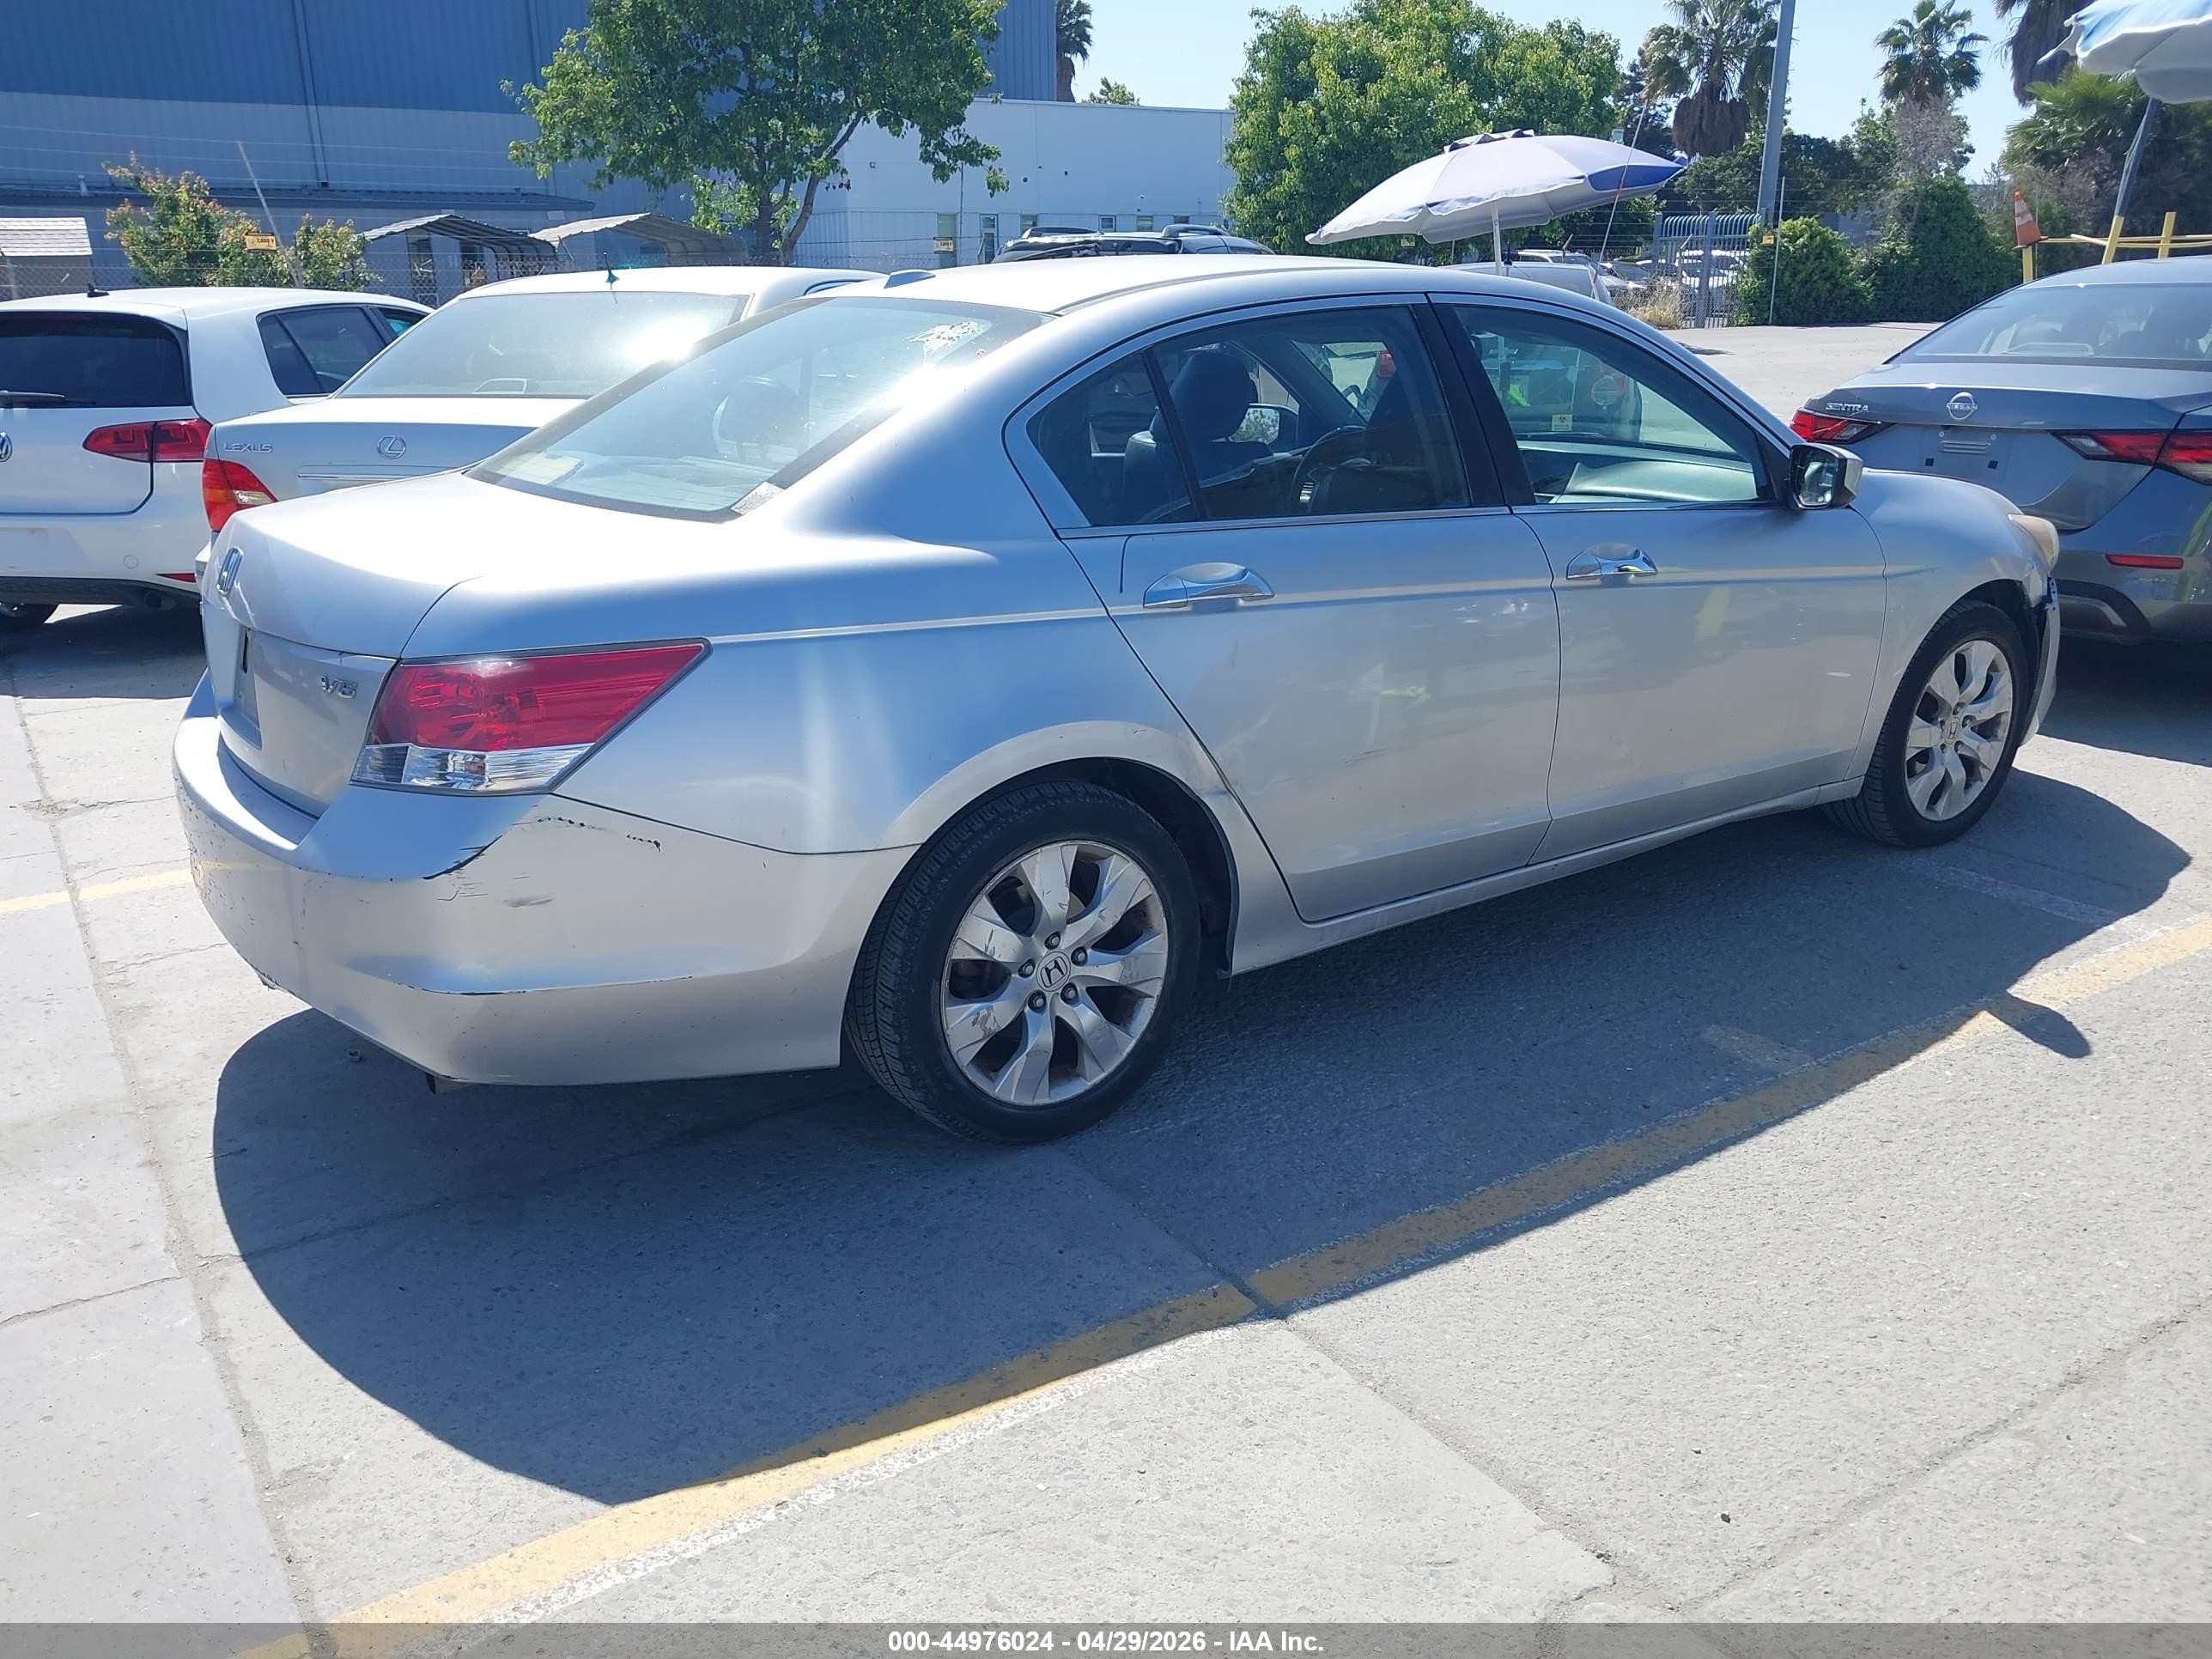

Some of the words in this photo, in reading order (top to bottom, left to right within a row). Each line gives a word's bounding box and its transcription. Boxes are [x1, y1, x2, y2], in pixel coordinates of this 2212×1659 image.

[1826, 402, 1869, 412] SENTRA
[1946, 402, 1978, 411] NISSAN
[223, 441, 273, 453] LEXUS
[320, 675, 357, 699] V6
